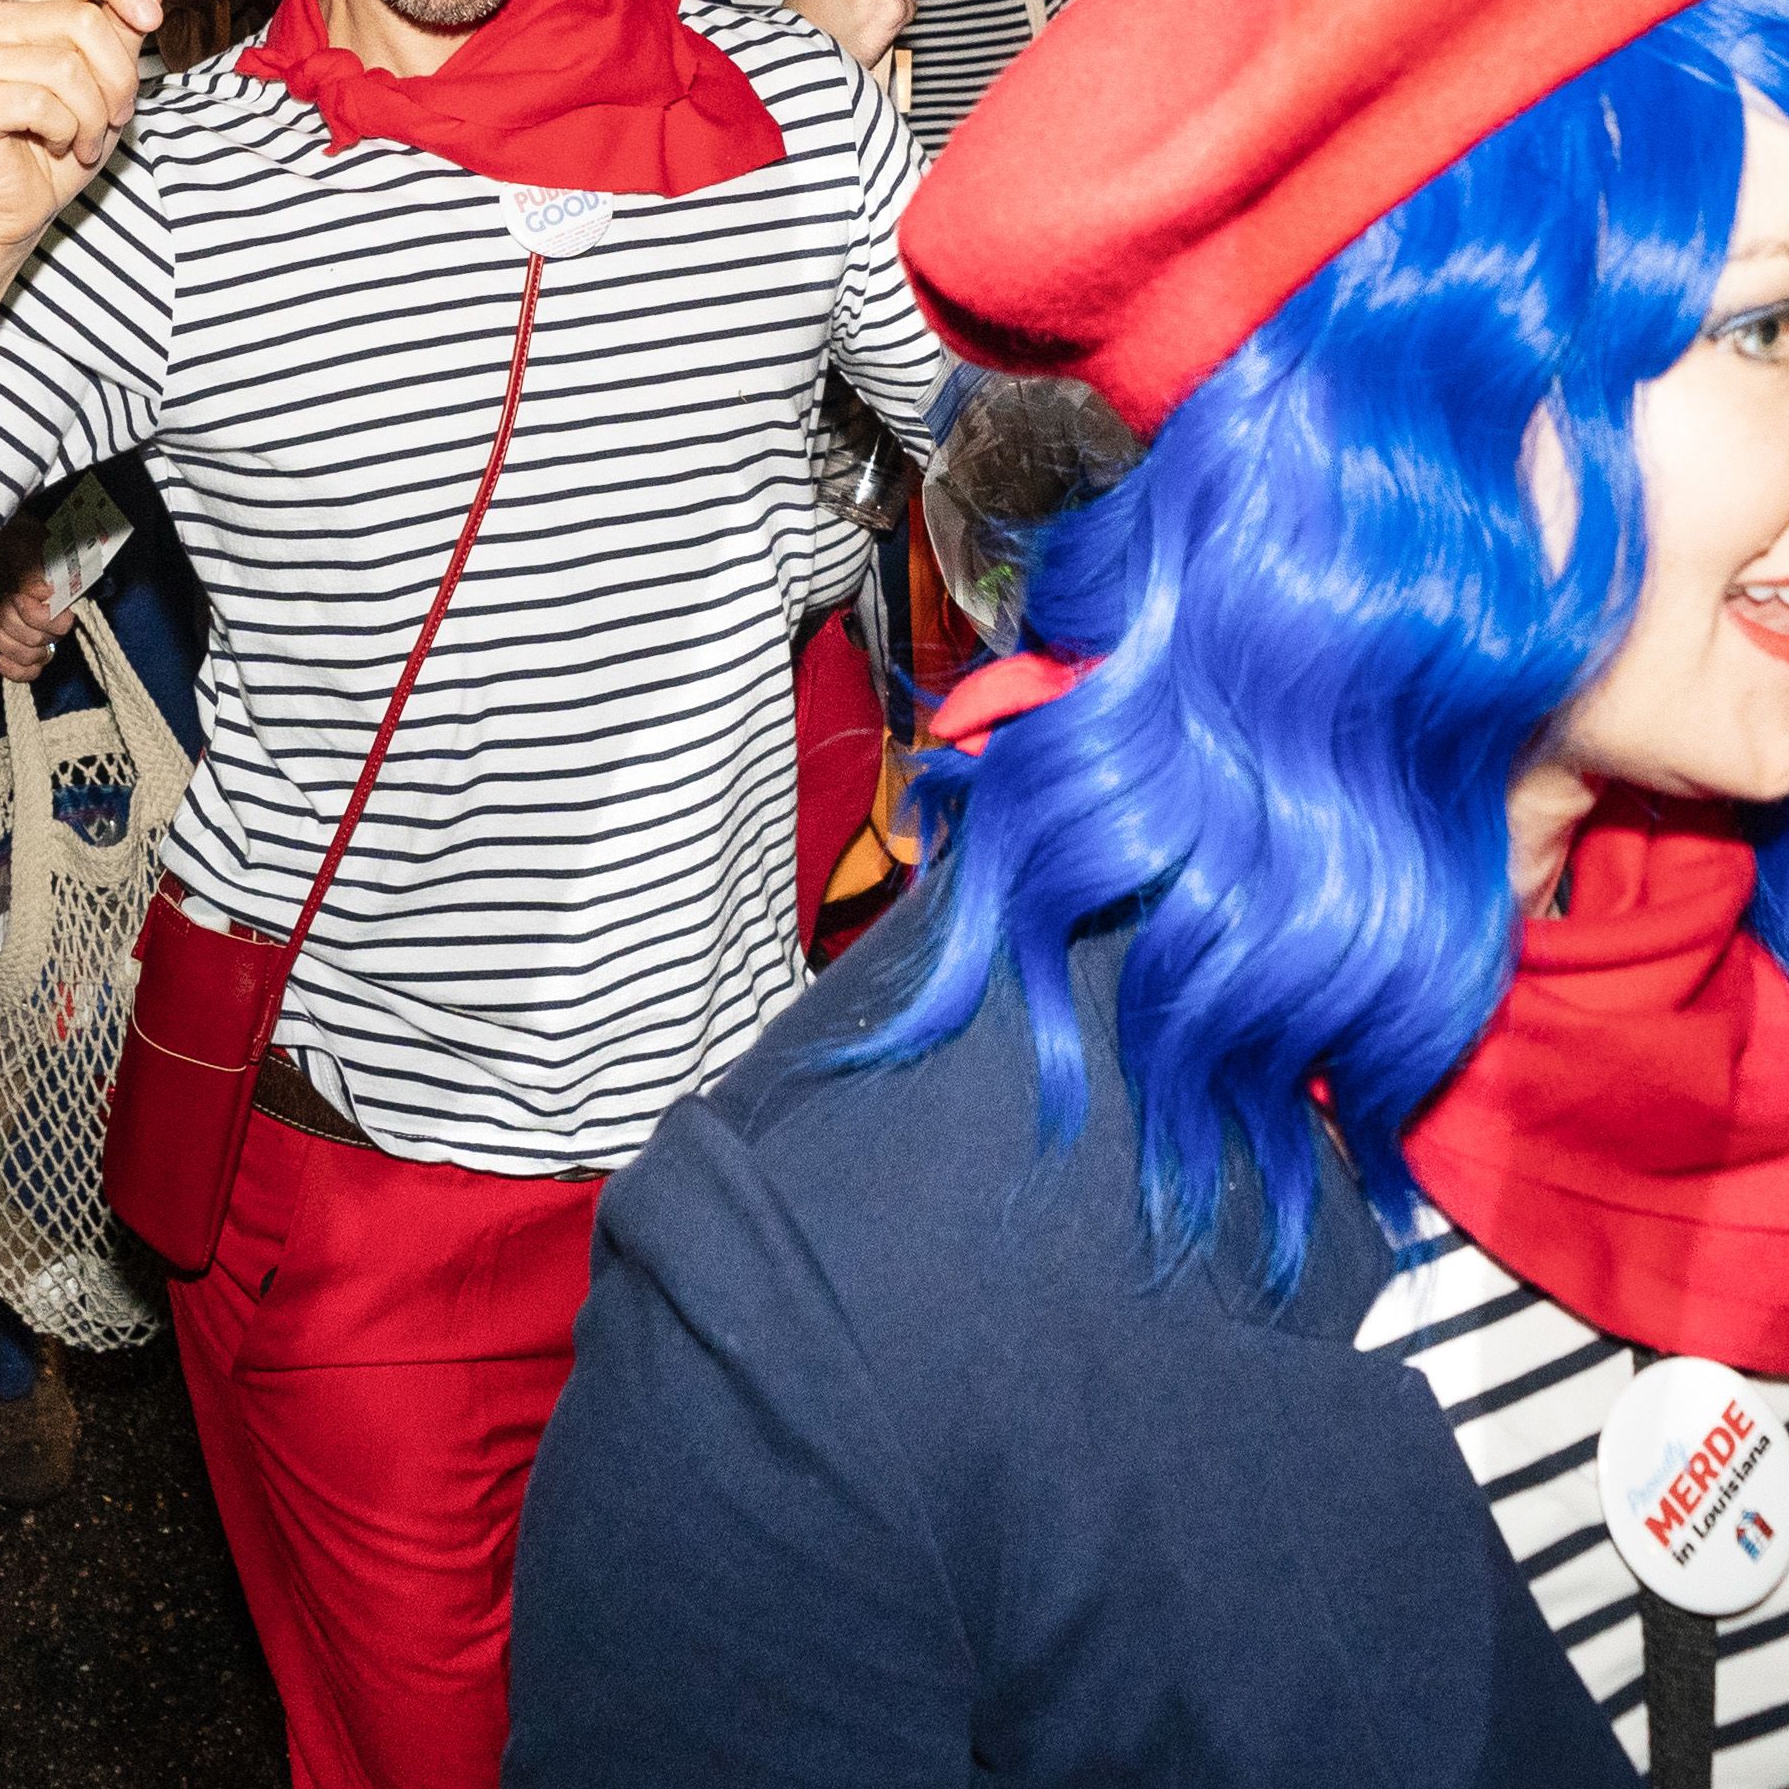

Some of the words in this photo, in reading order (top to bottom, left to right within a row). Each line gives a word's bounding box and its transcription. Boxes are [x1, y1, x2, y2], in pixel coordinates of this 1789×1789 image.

[1644, 1399, 1755, 1548] MERDE
[1672, 1541, 1696, 1570] in
[1692, 1434, 1771, 1540] Louisiana
